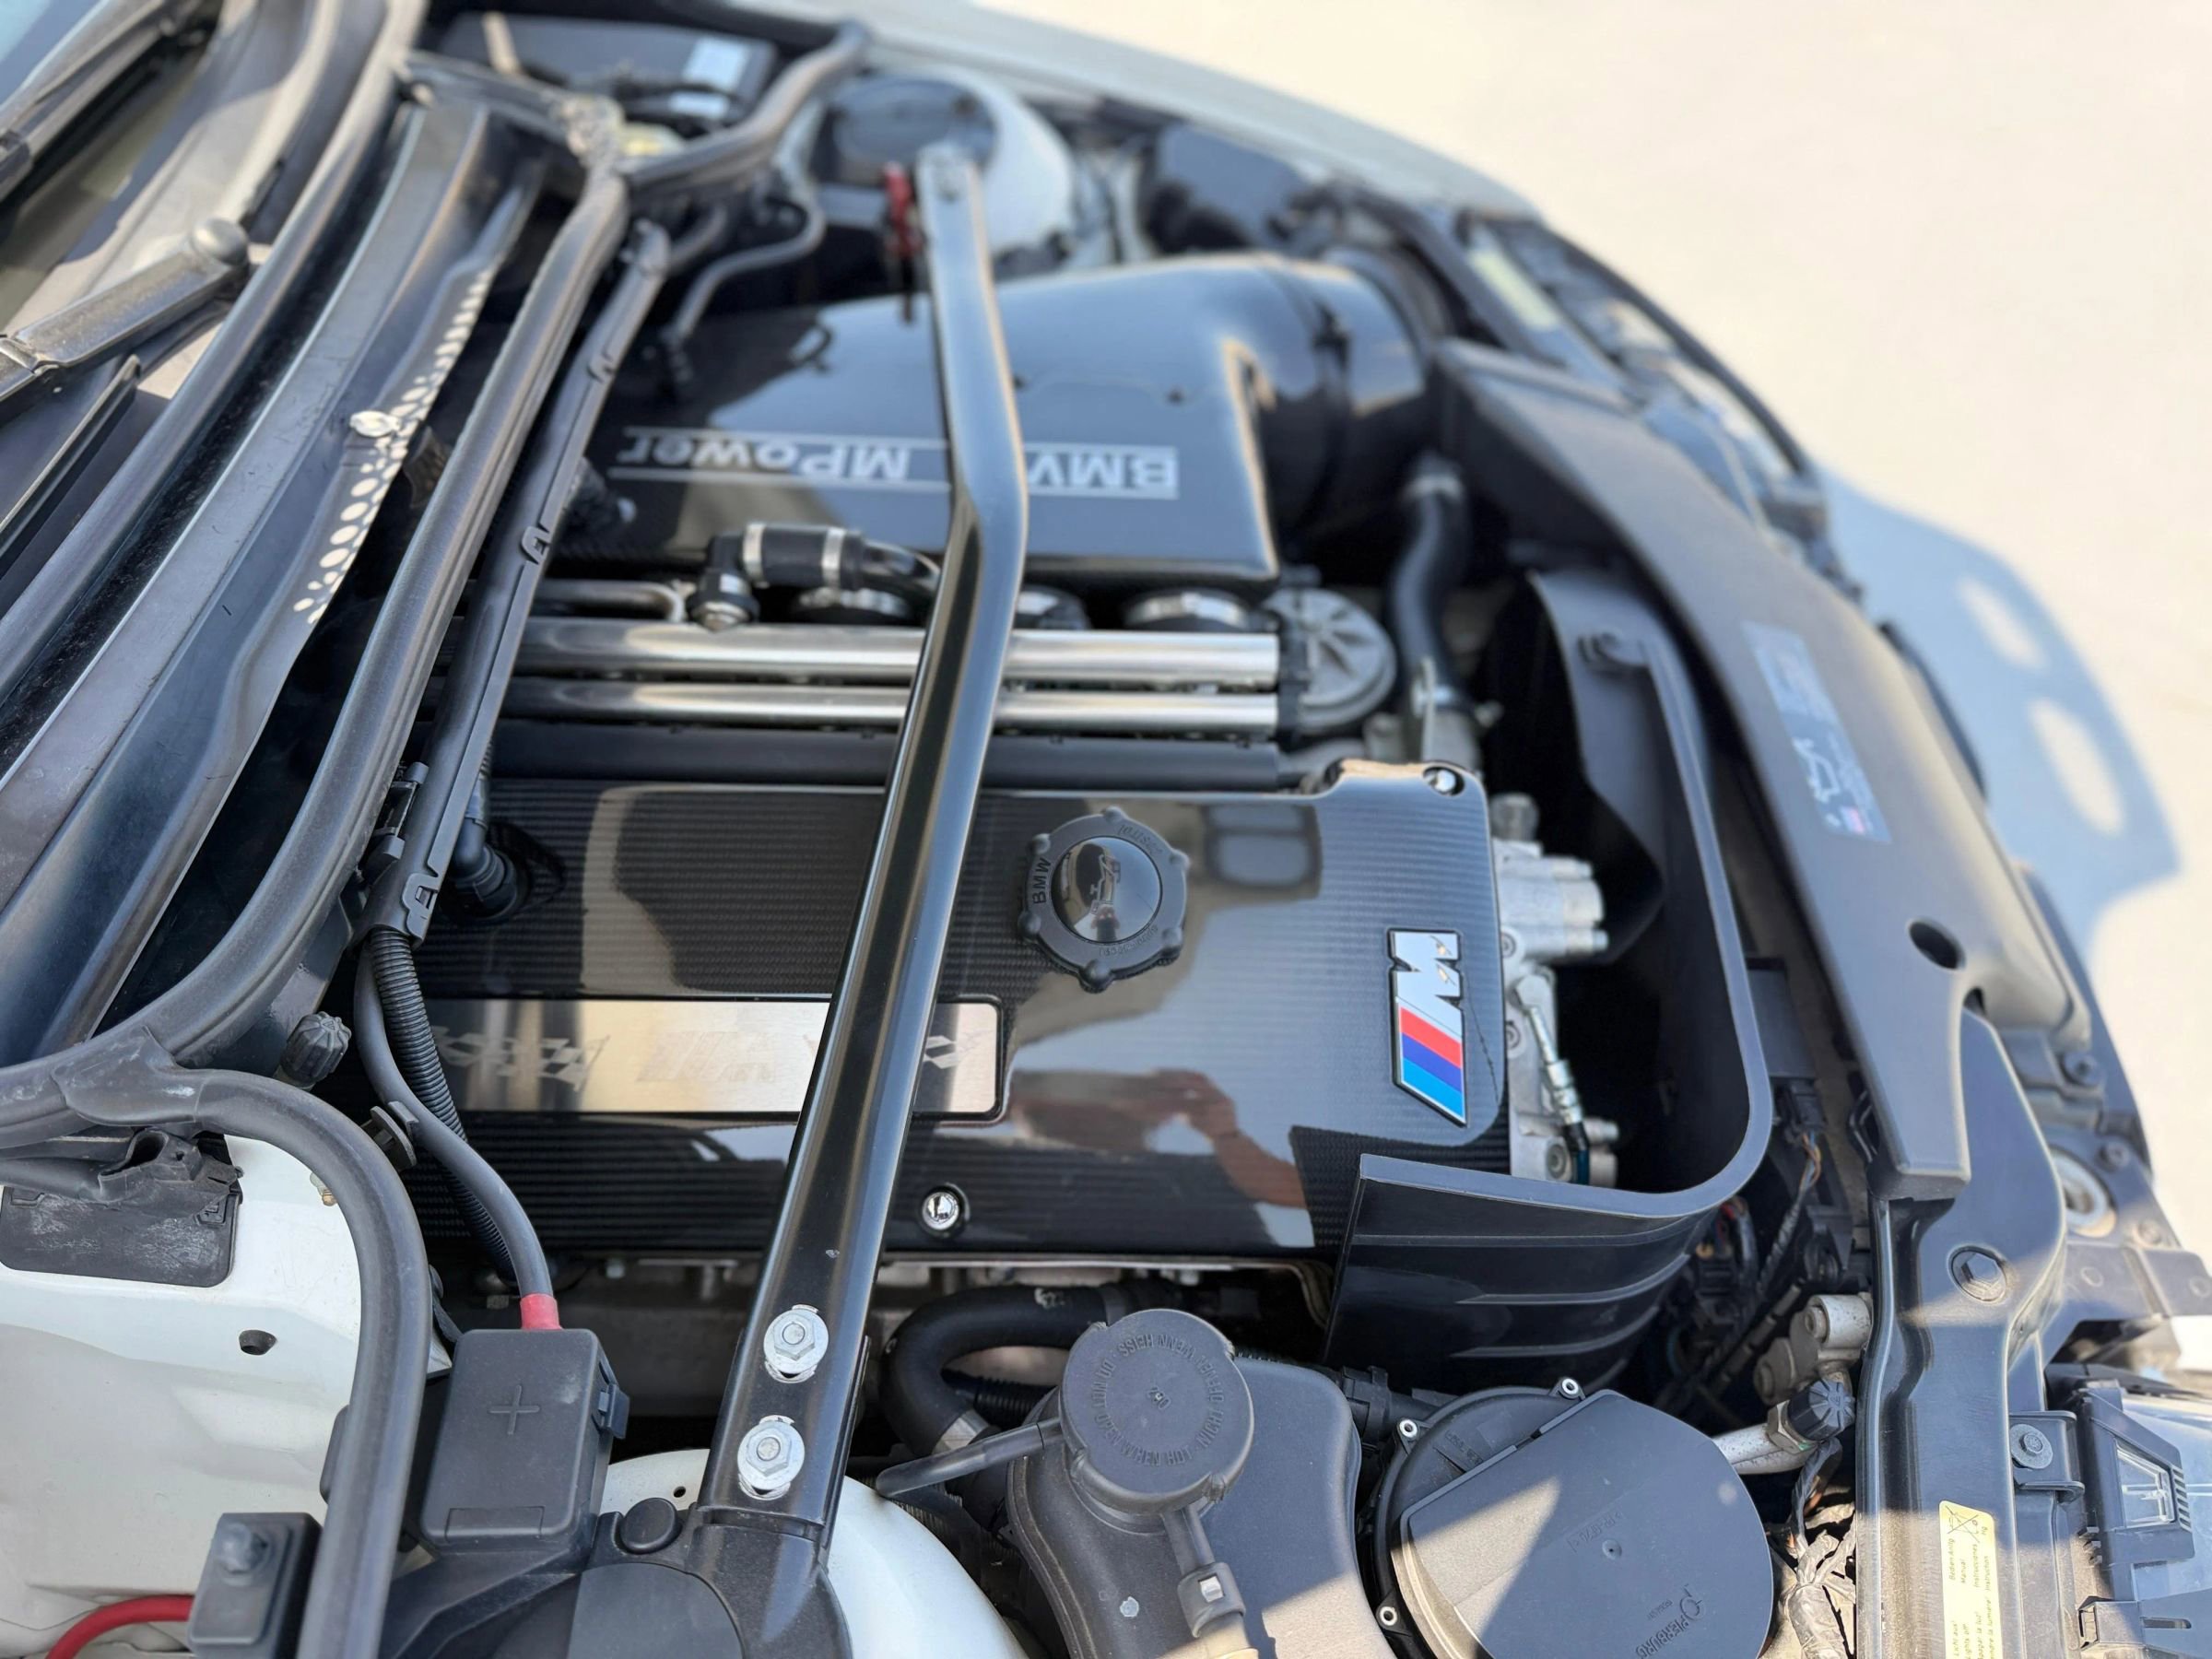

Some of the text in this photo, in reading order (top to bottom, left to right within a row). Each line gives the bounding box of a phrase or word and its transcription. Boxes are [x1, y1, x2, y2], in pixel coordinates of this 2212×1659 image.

[616, 435, 910, 478] MPower
[1032, 857, 1052, 904] BMW
[1118, 1334, 1154, 1357] HEISS
[1158, 1334, 1196, 1359] WENN
[1090, 1359, 1193, 1466] DO NOT OPEN WHEN HOT
[1195, 1408, 1225, 1448] NICHT
[1635, 1615, 1689, 1659] PIERBURG
